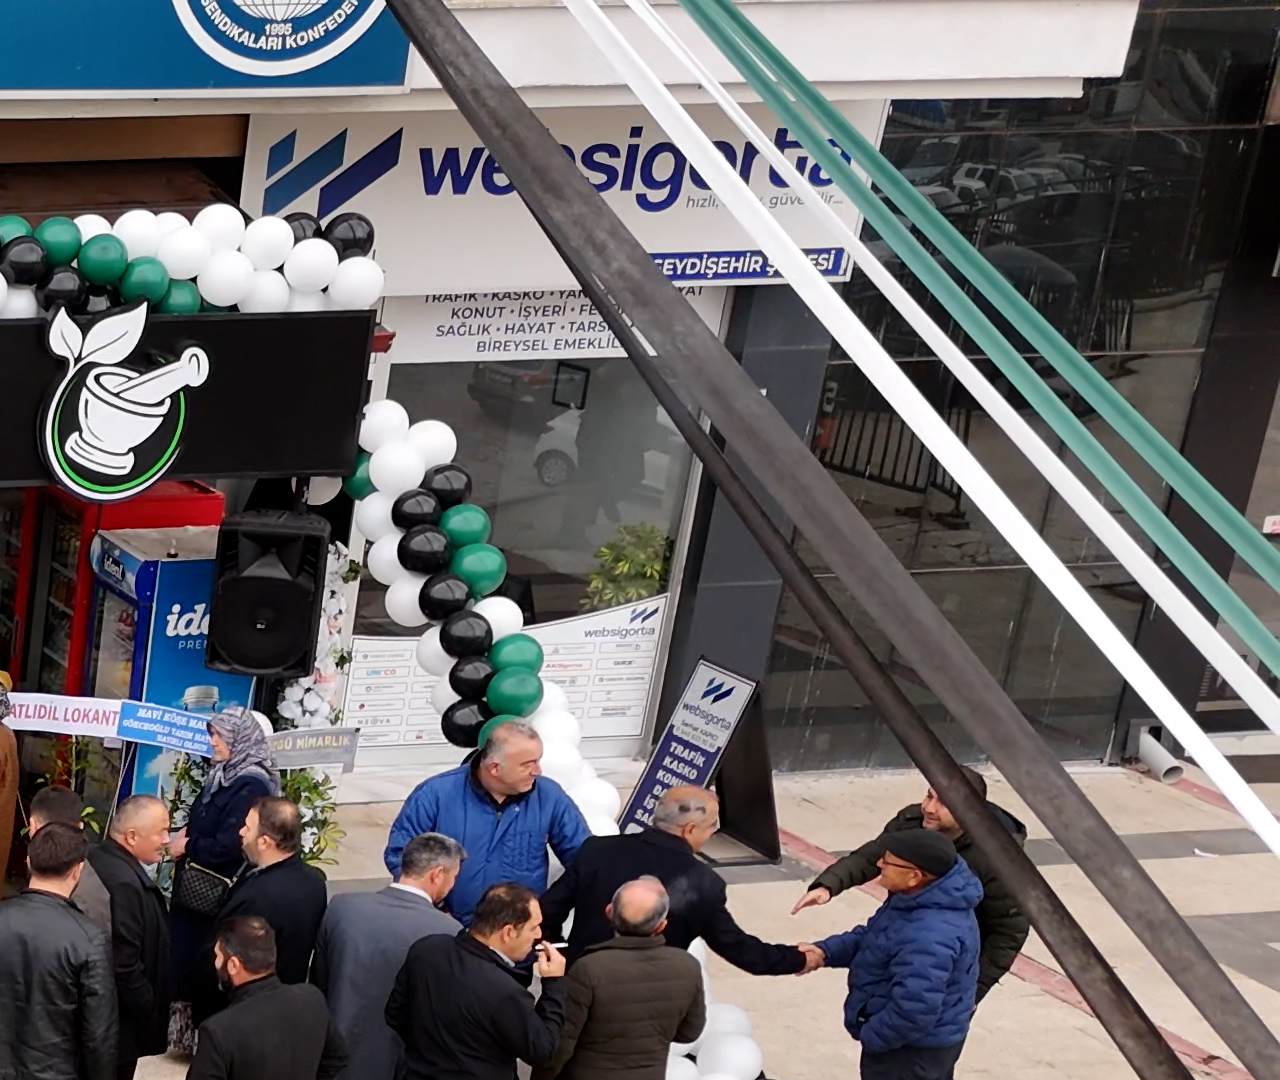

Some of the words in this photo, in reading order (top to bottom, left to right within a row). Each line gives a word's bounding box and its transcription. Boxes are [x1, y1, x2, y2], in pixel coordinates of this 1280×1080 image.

[264, 23, 293, 35] 1995
[451, 305, 507, 320] KONUT
[518, 302, 567, 321] İŞYERİ
[436, 322, 492, 338] SAĞLIK
[504, 322, 557, 336] HAYAT
[476, 337, 549, 353] BİREYSEL
[553, 336, 625, 351] EMEKLİL
[584, 626, 656, 640] websigorta
[8, 701, 59, 721] ATLIDİL
[63, 707, 120, 727] LOKANT
[137, 707, 163, 720] MAVİ
[681, 701, 733, 732] websigorta
[296, 734, 350, 750] MİMARLIK
[669, 742, 707, 768] TRAFİK
[662, 755, 699, 780] KASKO
